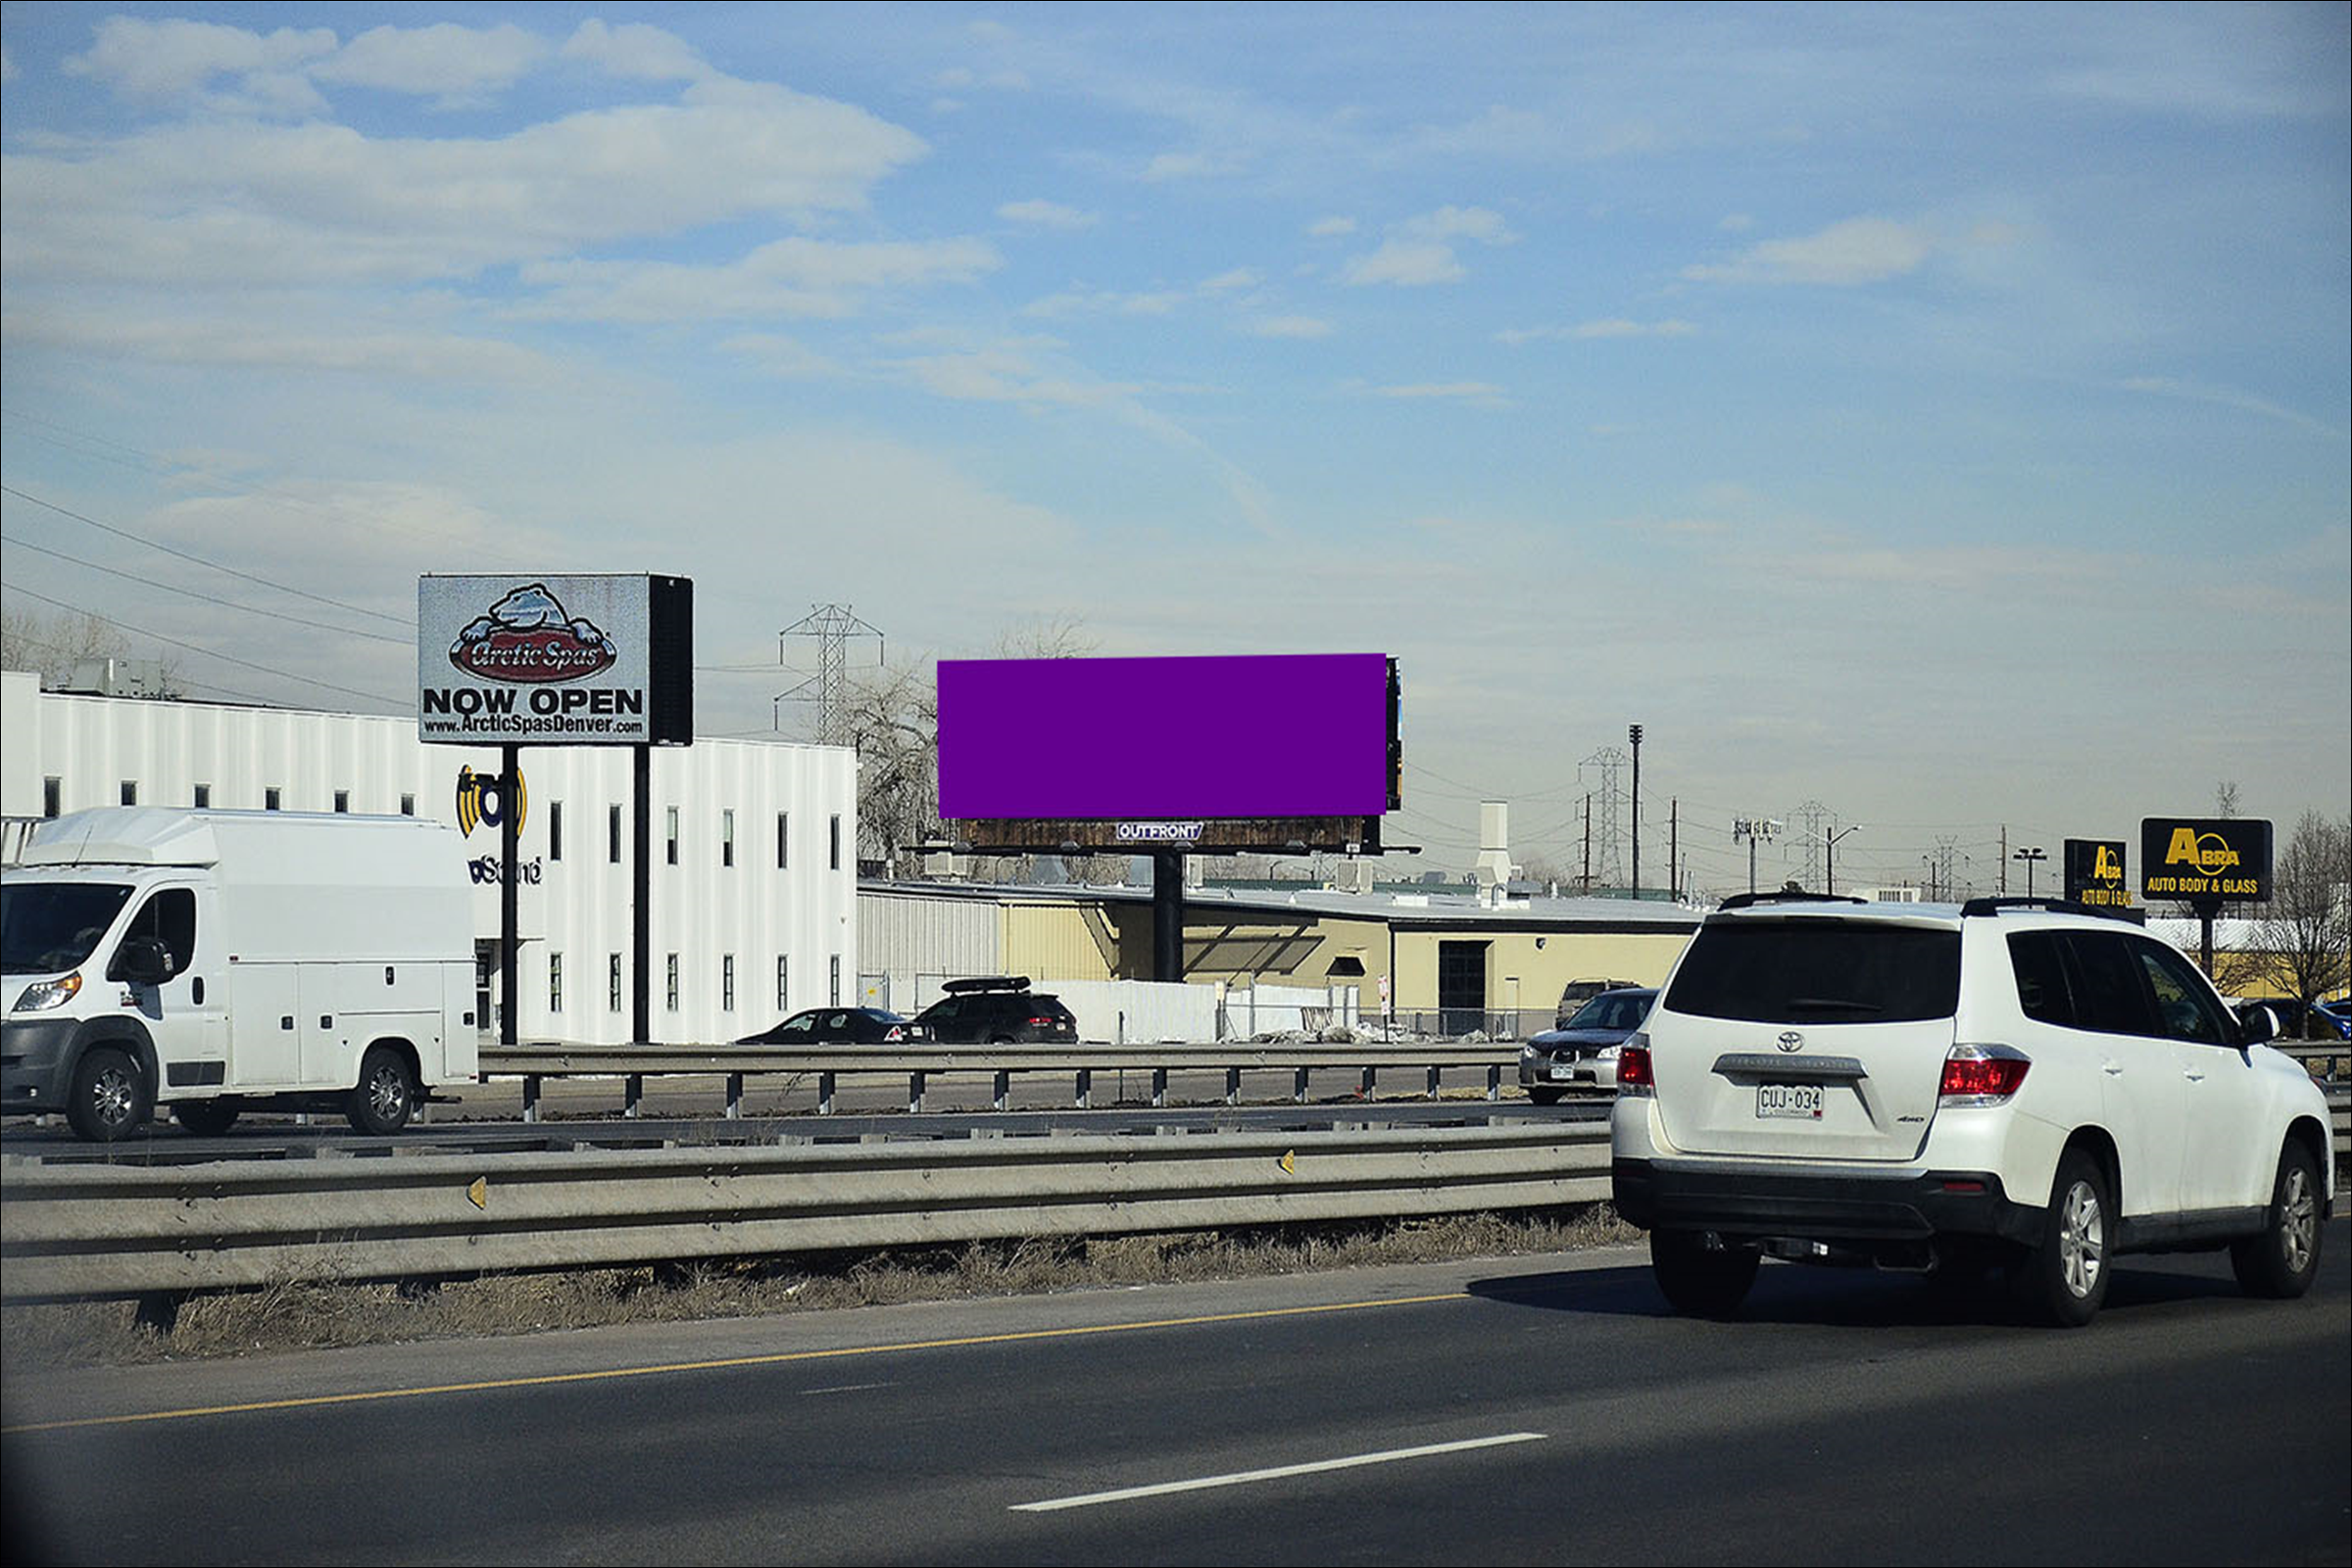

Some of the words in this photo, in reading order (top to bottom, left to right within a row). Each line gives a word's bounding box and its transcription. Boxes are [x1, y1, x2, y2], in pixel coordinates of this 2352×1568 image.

[542, 641, 599, 670] Spas
[422, 688, 516, 714] NOW
[529, 688, 643, 714] OPEN
[424, 714, 643, 735] www.ArcticSpasDenver.com
[1119, 824, 1198, 839] OUTFRONT
[2147, 877, 2176, 892] AUTO
[2180, 877, 2209, 892] BODY
[2211, 878, 2220, 893] &
[2223, 879, 2258, 894] GLASS
